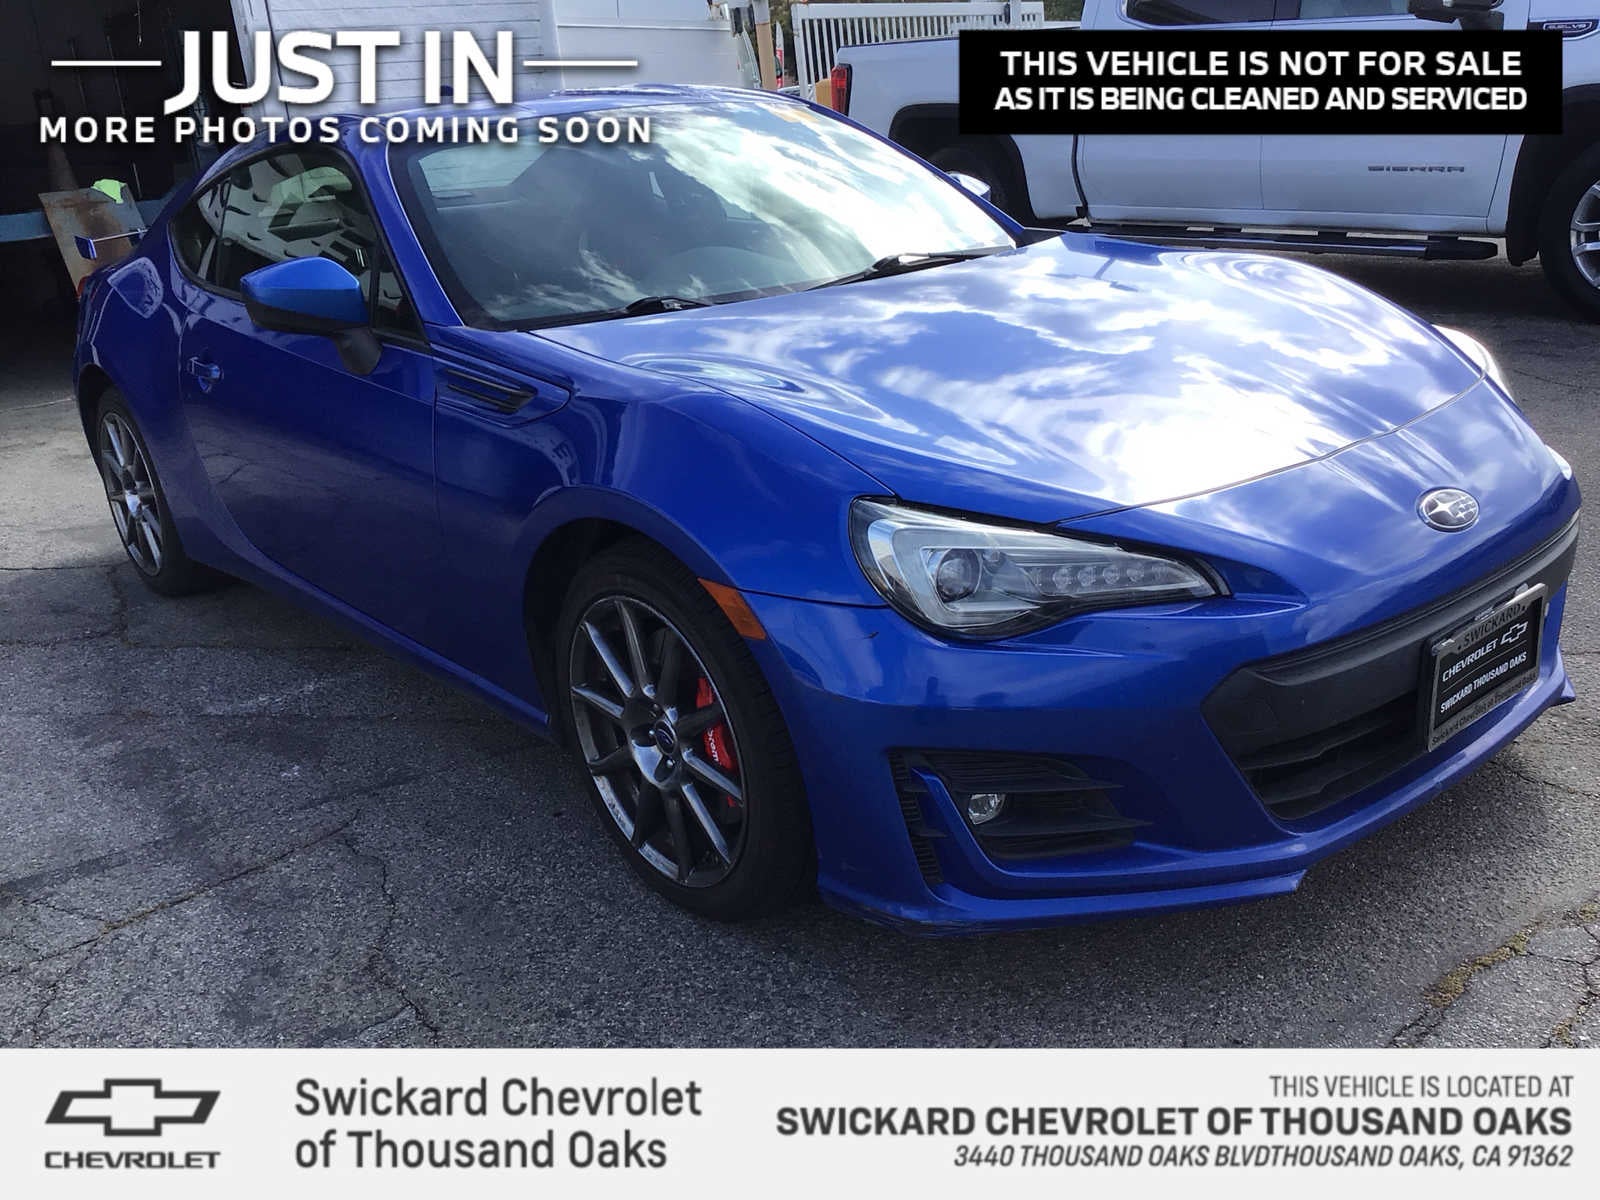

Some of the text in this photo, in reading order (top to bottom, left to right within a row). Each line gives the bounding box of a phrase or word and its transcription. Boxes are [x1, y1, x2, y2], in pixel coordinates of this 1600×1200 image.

[1464, 603, 1521, 645] SWICKARD
[1440, 684, 1473, 713] SWICKARD
[1473, 661, 1509, 690] THOUSAND
[1509, 651, 1528, 670] OAKS
[1442, 637, 1498, 682] CHEVROLET
